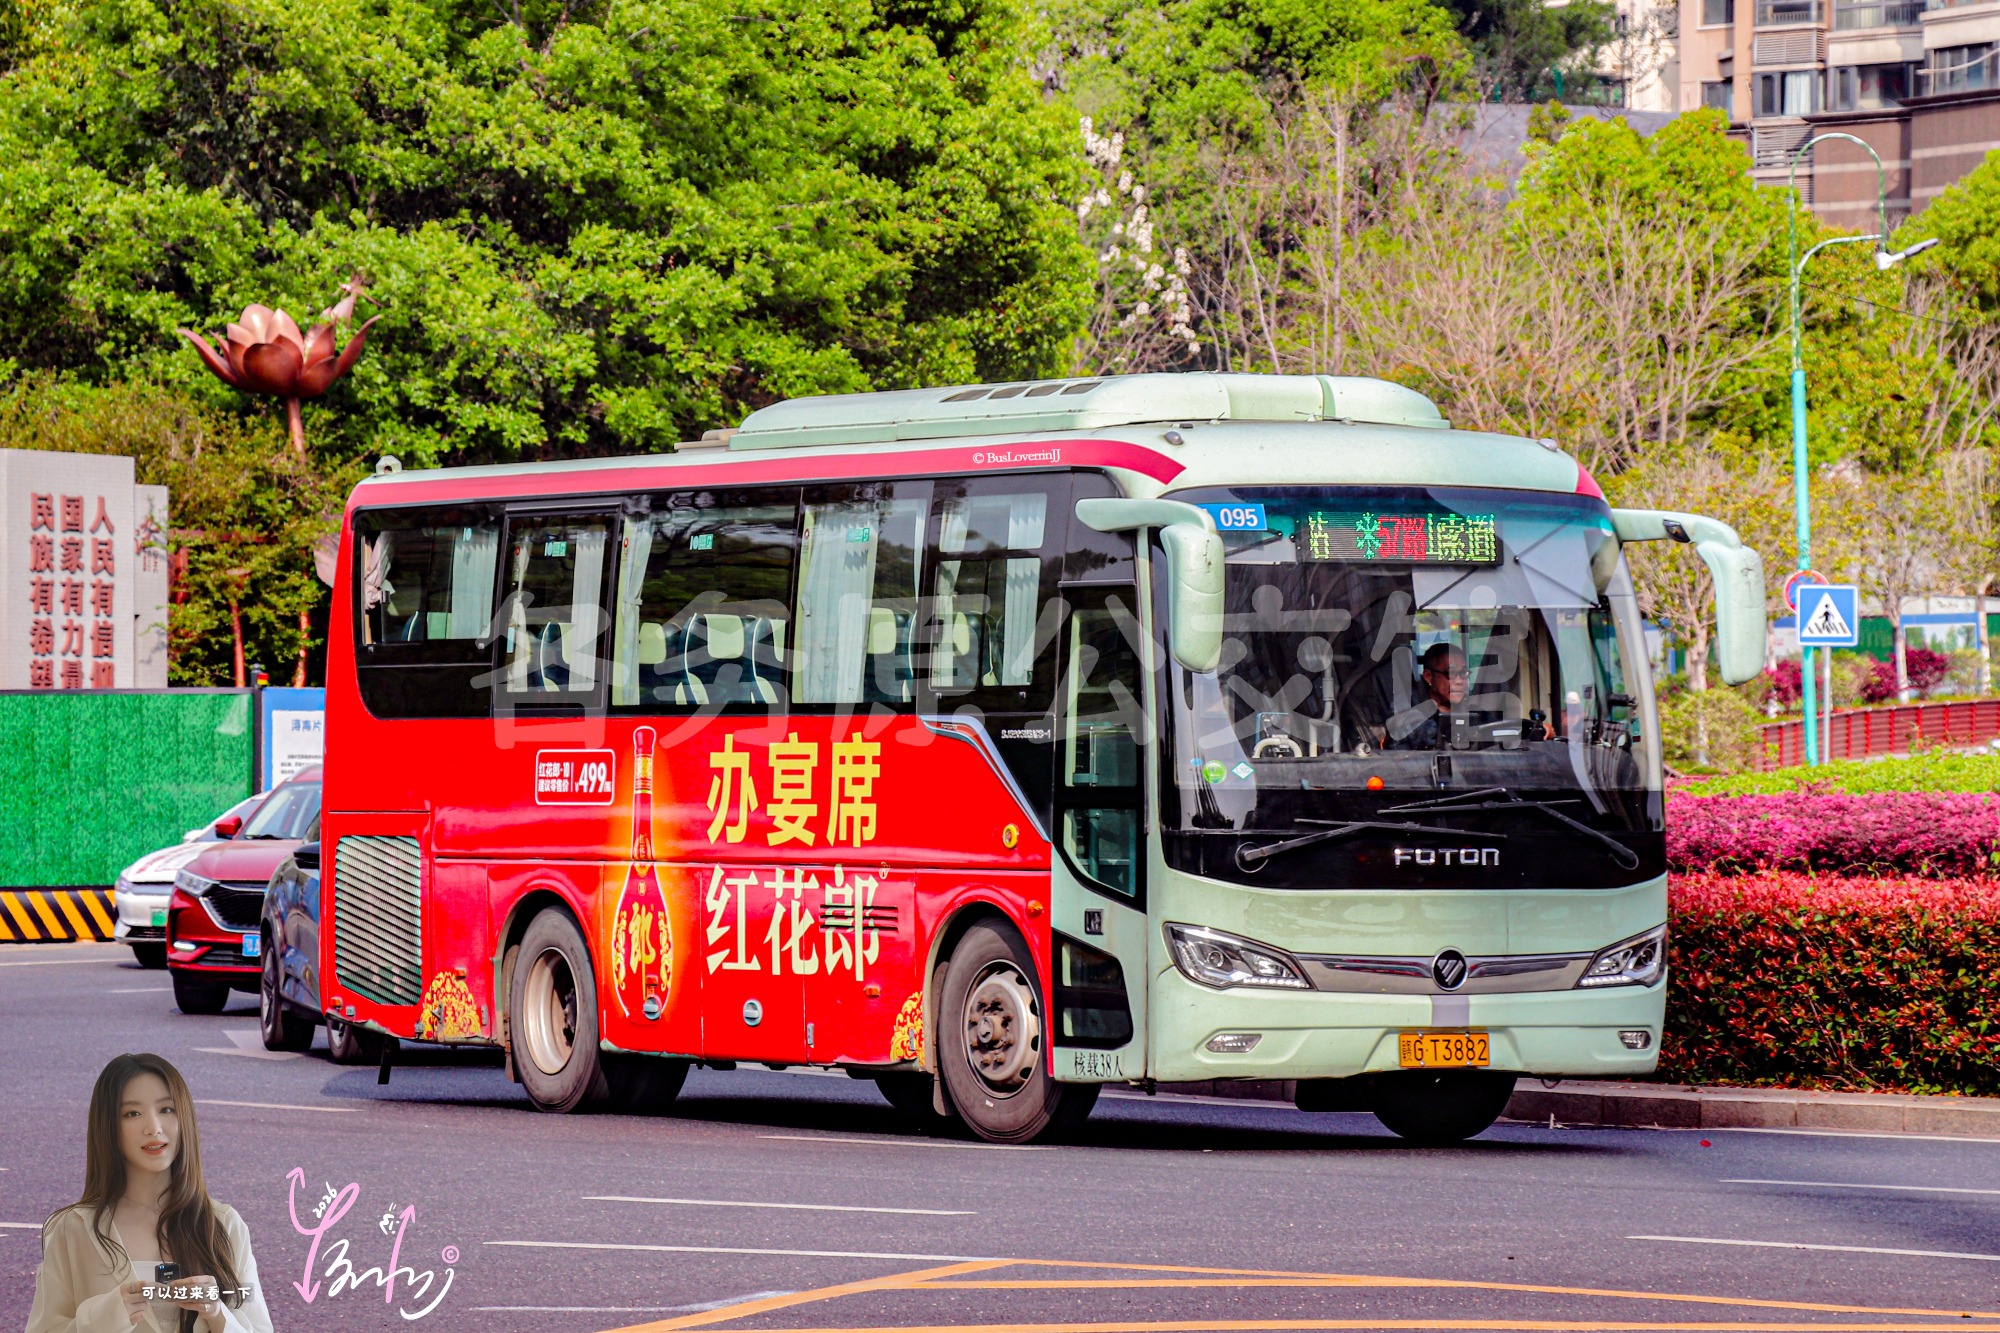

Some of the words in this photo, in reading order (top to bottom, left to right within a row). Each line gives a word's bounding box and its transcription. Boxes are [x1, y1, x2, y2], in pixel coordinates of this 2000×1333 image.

[1219, 507, 1259, 528] 095
[29, 492, 55, 688] 民族有希望
[59, 494, 85, 688] 国家有力量
[89, 496, 115, 688] 人民有信仰
[706, 731, 882, 848] 办宴席
[1393, 848, 1500, 866] FOTON
[705, 863, 880, 982] 红花郎
[1074, 1051, 1123, 1078] 核载38人
